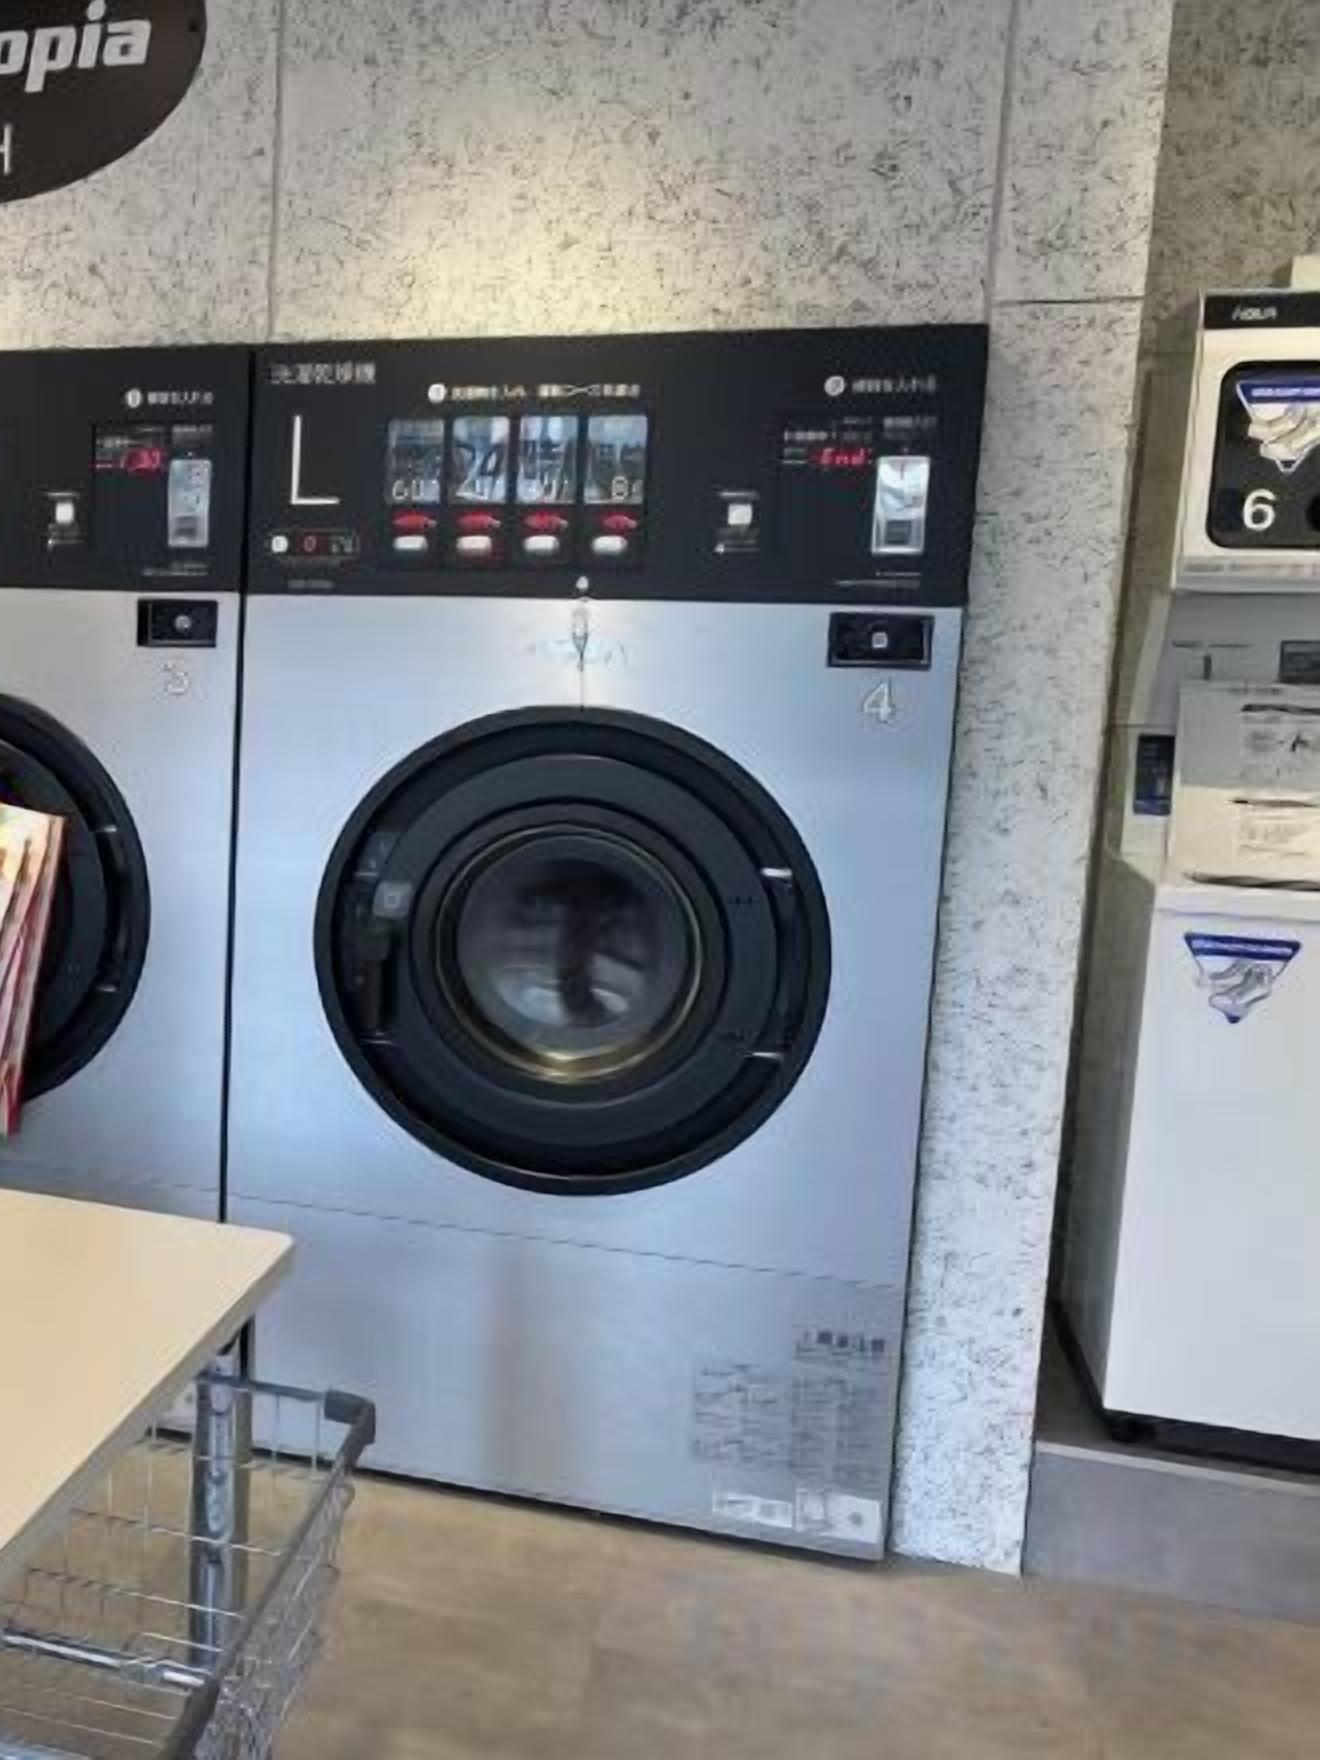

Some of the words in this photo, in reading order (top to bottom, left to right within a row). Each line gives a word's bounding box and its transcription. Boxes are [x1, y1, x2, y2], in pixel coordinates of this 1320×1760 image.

[292, 415, 340, 503] L
[1242, 488, 1277, 531] 6
[862, 679, 894, 721] 4
